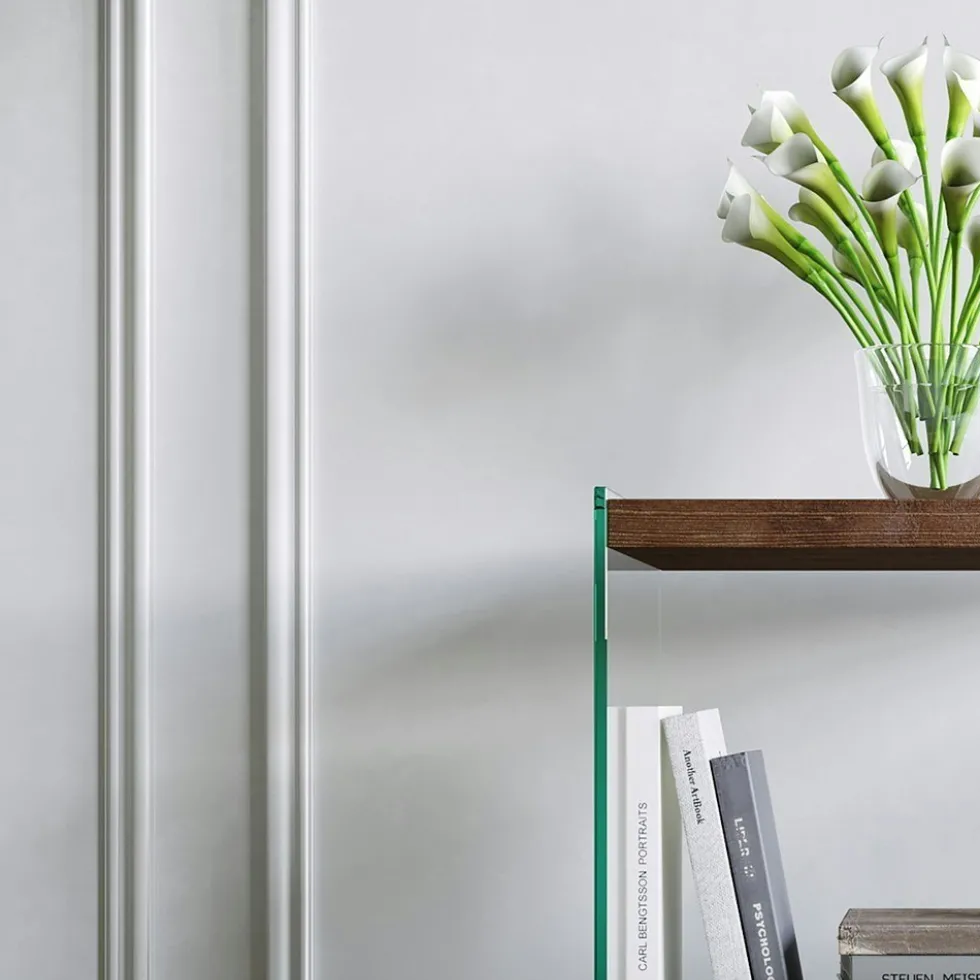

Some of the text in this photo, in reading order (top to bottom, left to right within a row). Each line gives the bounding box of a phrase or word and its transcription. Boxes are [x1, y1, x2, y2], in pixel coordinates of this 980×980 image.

[682, 749, 697, 788] Another
[638, 801, 648, 972] CARL BENGTSSON PORTRAITS
